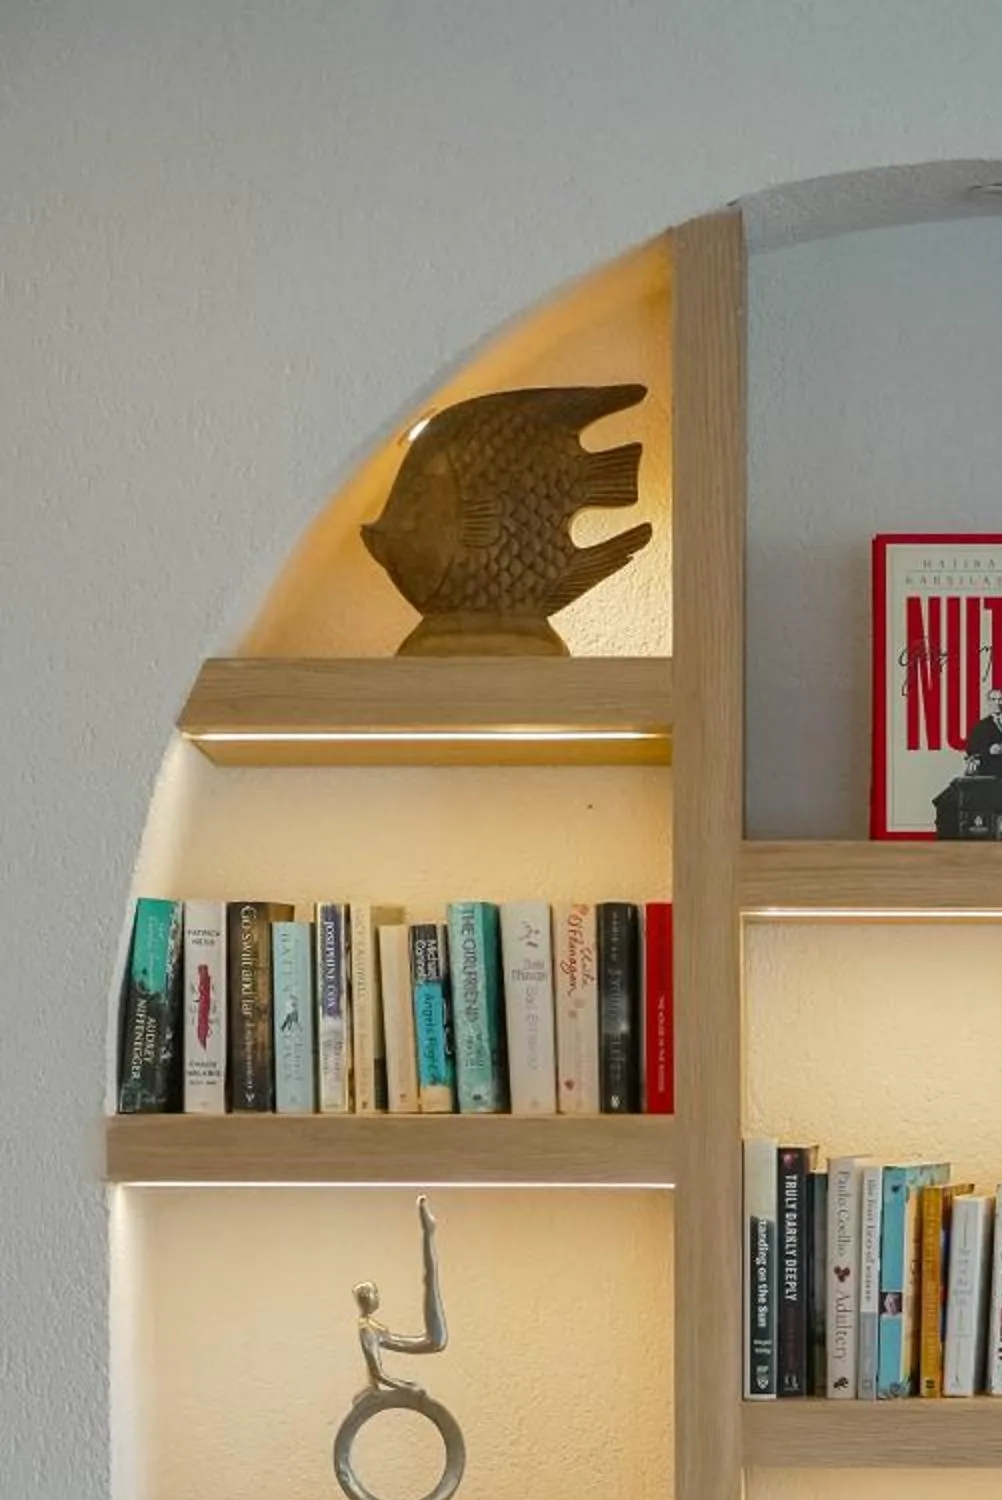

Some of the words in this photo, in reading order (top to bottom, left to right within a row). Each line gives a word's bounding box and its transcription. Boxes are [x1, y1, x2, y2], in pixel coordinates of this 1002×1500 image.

[240, 906, 256, 930] Go
[461, 909, 476, 936] THE
[240, 934, 257, 966] swift
[323, 921, 337, 981] JOSEPHINE
[240, 968, 256, 996] and
[326, 985, 338, 1009] COX
[462, 939, 480, 1023] GIRLFRIEND
[423, 994, 437, 1034] Angels
[131, 999, 151, 1081] NIFFENEGGER
[143, 1016, 157, 1064] AUDREY
[784, 1174, 799, 1209] TRULY
[836, 1169, 852, 1207] Paulo
[755, 1217, 770, 1264] tanding
[784, 1212, 799, 1256] DARKLY
[837, 1208, 852, 1257] Coelho
[757, 1267, 768, 1282] on
[757, 1284, 769, 1303] the
[784, 1259, 798, 1301] DEEPLY
[757, 1305, 769, 1328] Sun
[833, 1289, 852, 1363] Adultery
